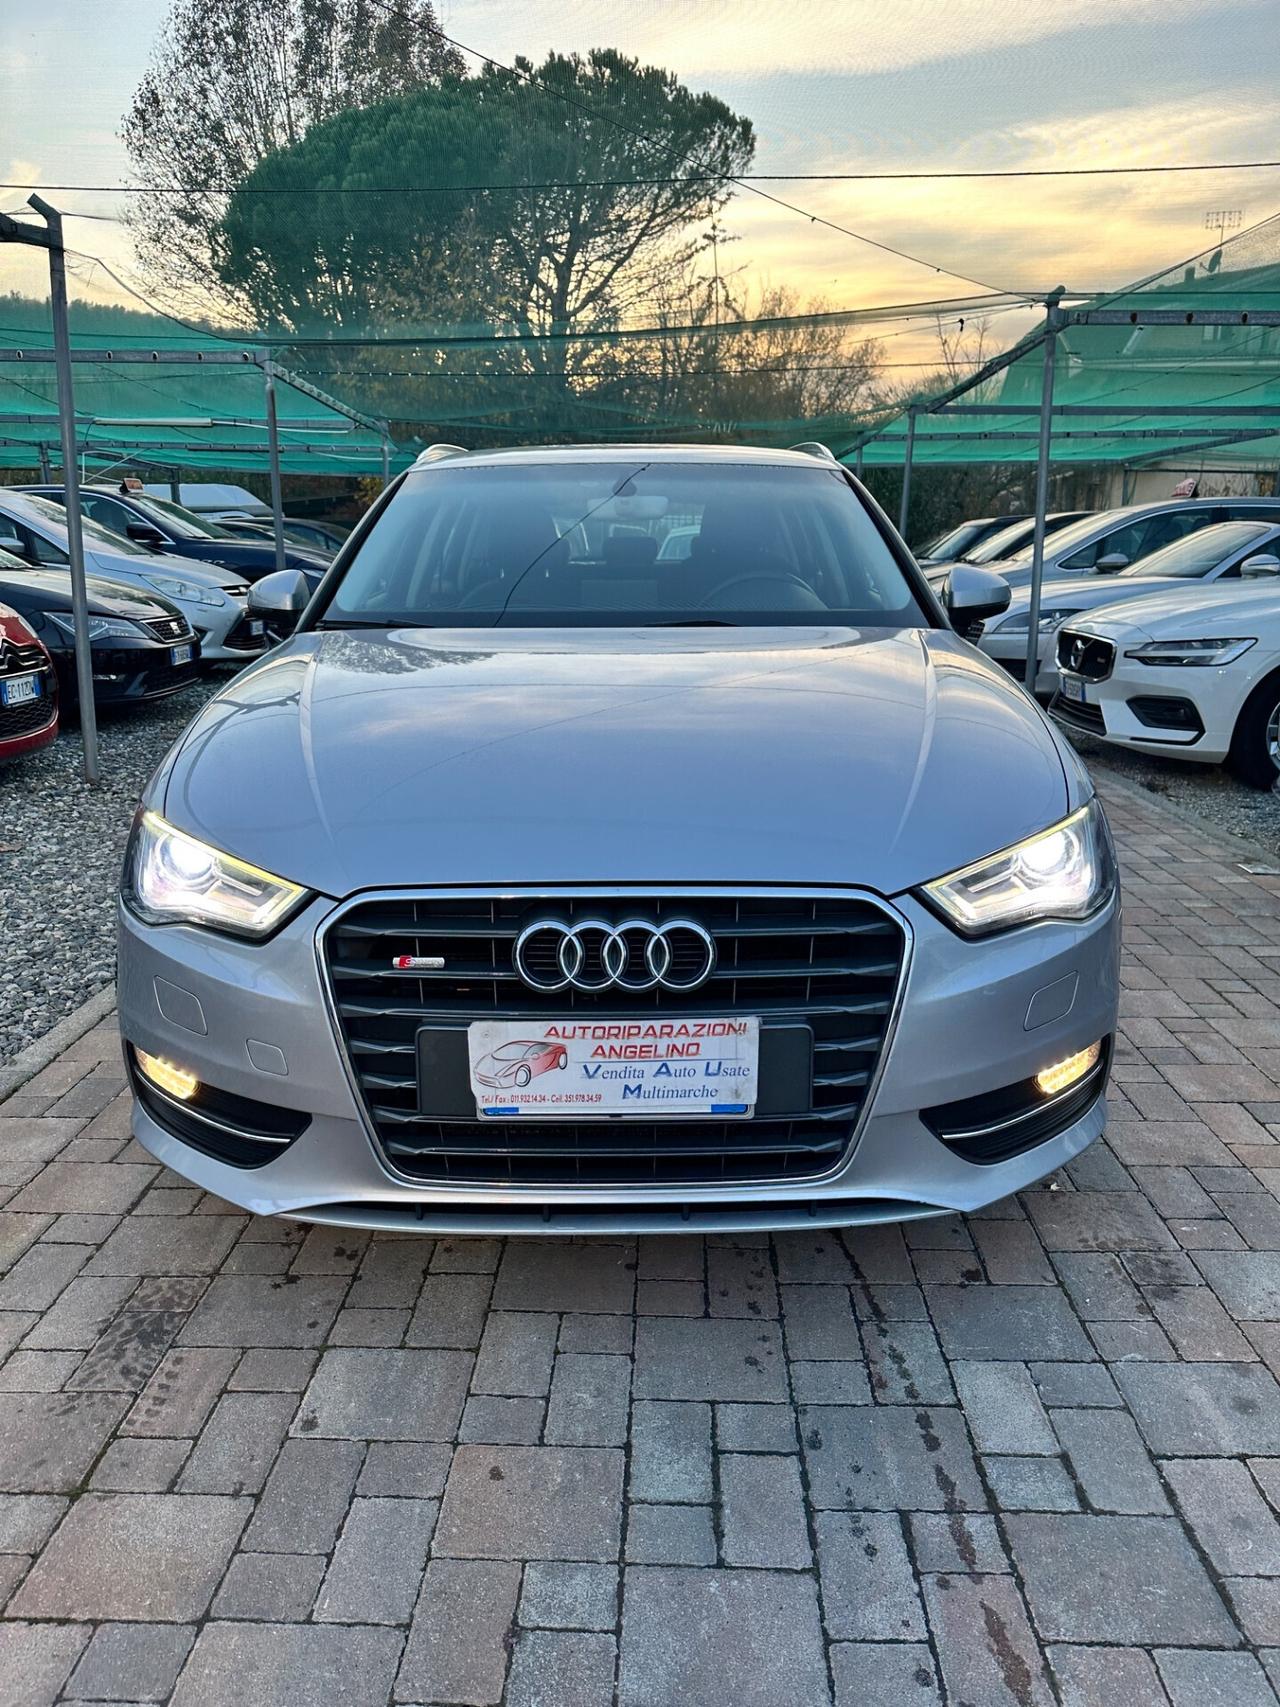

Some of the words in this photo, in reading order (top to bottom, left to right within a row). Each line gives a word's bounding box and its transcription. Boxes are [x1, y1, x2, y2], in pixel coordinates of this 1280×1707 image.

[544, 1022, 747, 1040] AUTORIPARAZIONI
[590, 1042, 701, 1059] ANGELINO
[582, 1063, 645, 1081] Vendita
[652, 1062, 697, 1079] Auto
[703, 1060, 751, 1078] Usate
[622, 1083, 719, 1100] Multimarche
